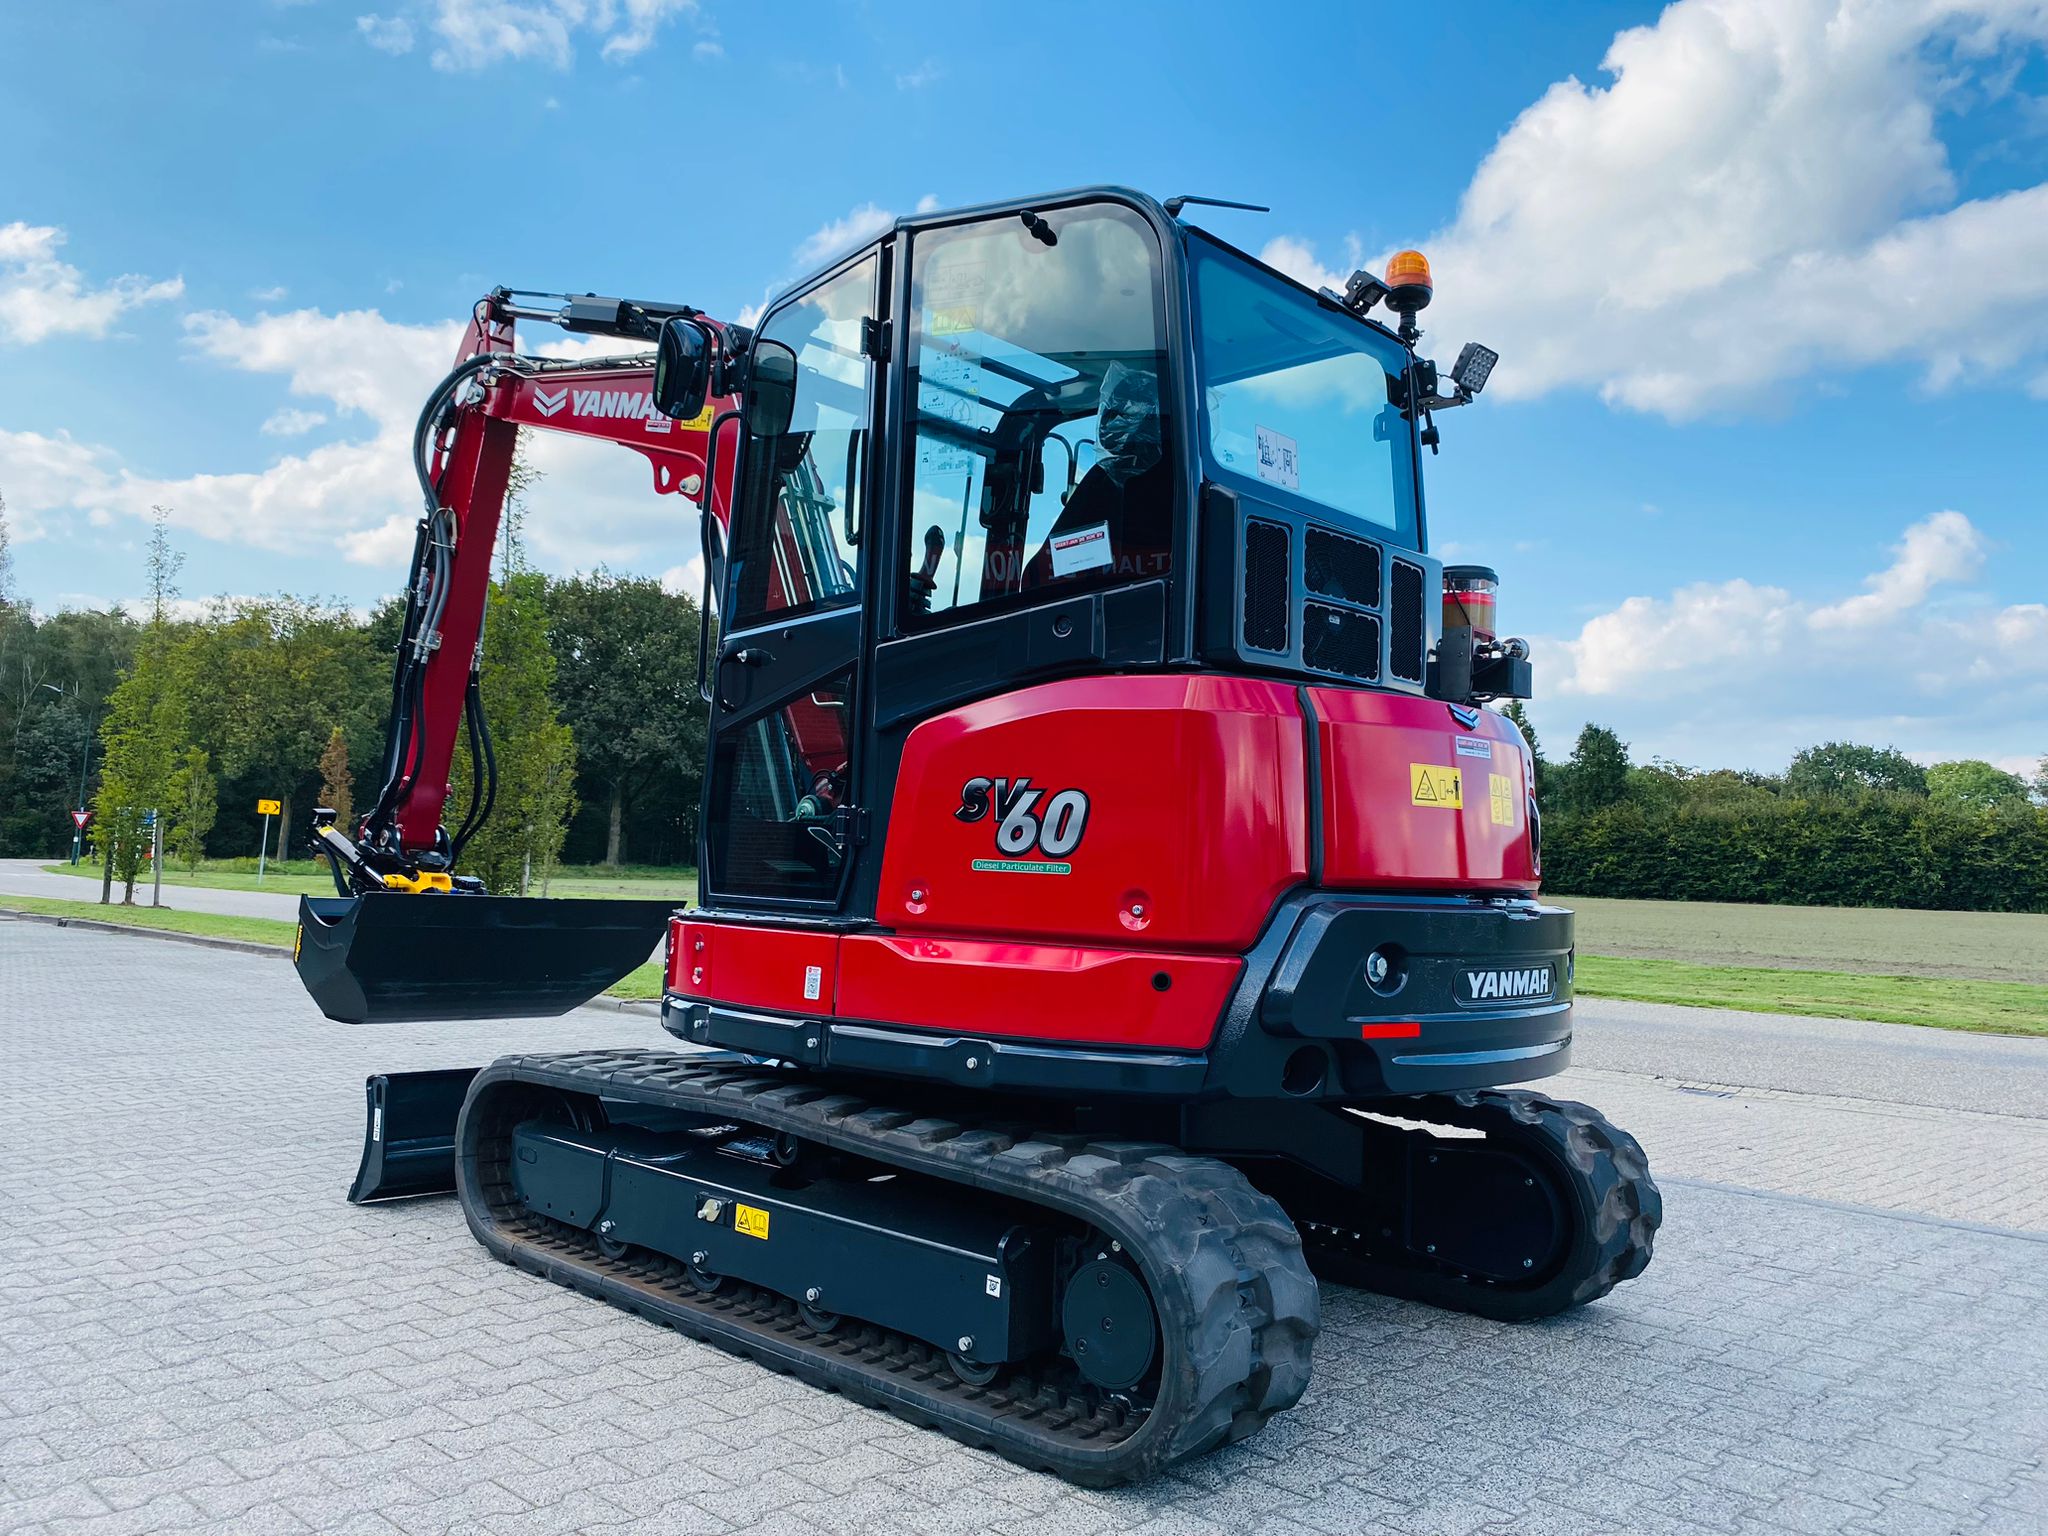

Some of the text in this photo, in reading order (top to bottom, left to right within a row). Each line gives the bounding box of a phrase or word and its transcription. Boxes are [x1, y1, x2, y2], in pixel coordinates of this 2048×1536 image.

[976, 861, 1068, 873] Diesel Particulate Filter
[1467, 968, 1550, 999] YANMAR
